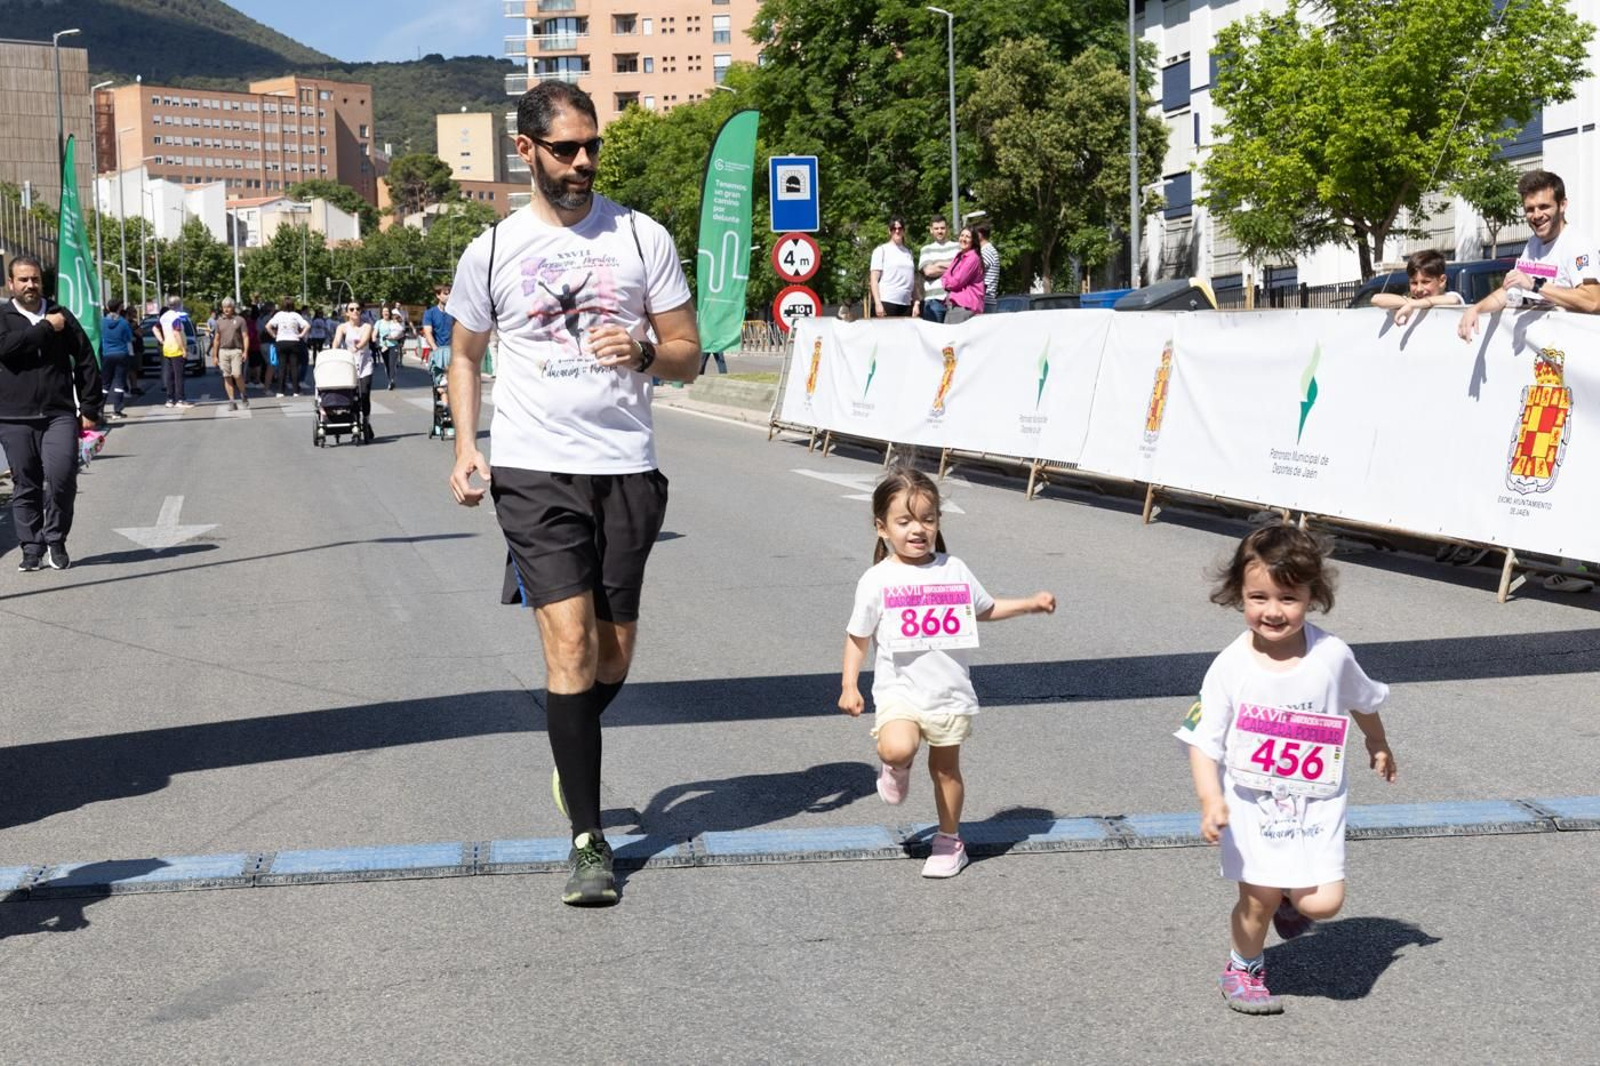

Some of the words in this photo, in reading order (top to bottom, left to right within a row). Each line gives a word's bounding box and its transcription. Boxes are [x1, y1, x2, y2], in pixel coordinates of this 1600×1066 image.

[715, 179, 747, 191] Tenemos
[724, 191, 741, 199] gran
[713, 197, 740, 207] camino
[713, 213, 740, 223] delante
[783, 249, 796, 266] 4
[800, 257, 810, 266] m
[795, 304, 806, 314] 10
[1292, 450, 1320, 465] Municipal
[1320, 454, 1330, 466] de
[887, 585, 922, 597] XXVII
[901, 608, 960, 637] 866
[1251, 739, 1324, 780] 456
